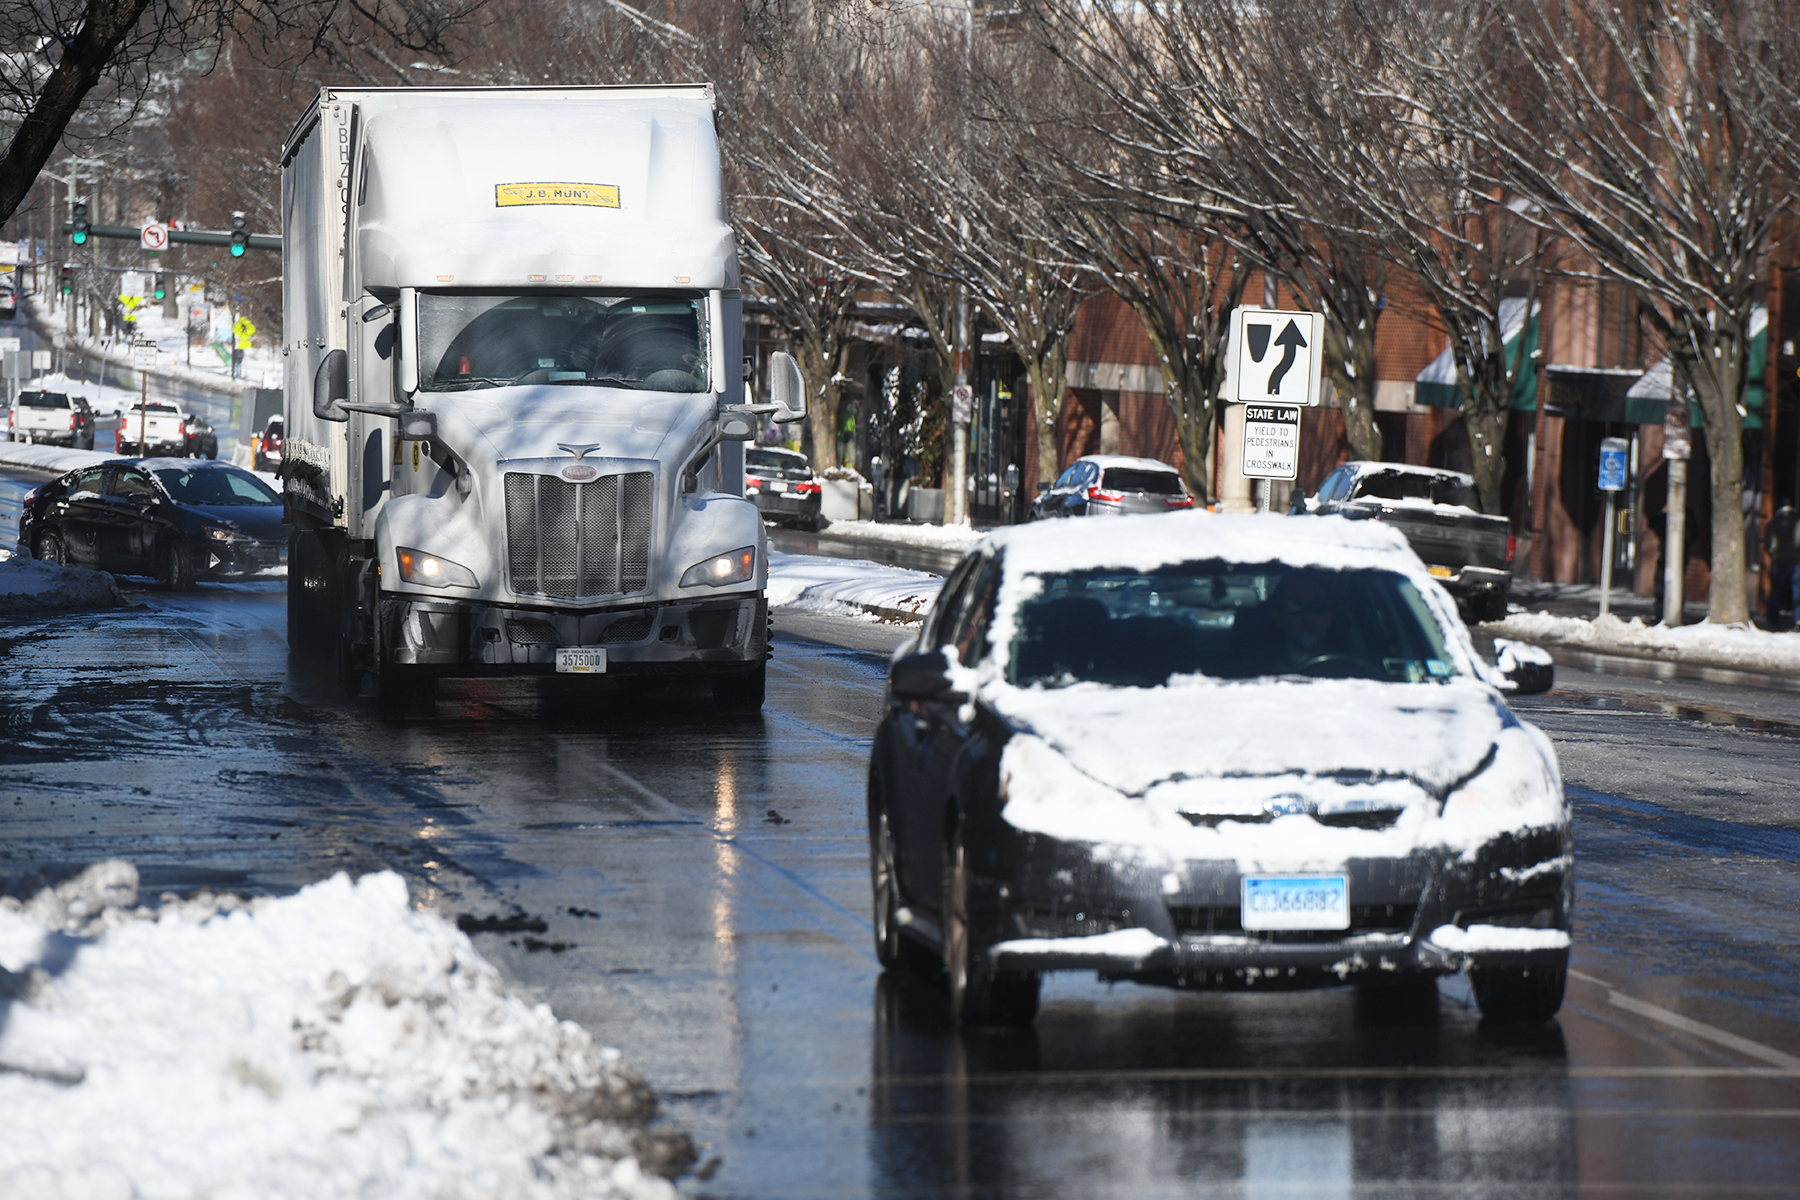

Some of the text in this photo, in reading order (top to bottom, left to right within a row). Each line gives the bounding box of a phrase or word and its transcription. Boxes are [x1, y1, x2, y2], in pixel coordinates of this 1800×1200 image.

[553, 190, 591, 198] HUNT
[1246, 408, 1298, 421] STATE LAW
[1254, 426, 1289, 436] YIELD TO
[1246, 437, 1294, 448] PEDESTRIANS
[1265, 449, 1274, 458] IN
[1246, 460, 1292, 470] CROSSWALK
[562, 654, 600, 666] 3575000
